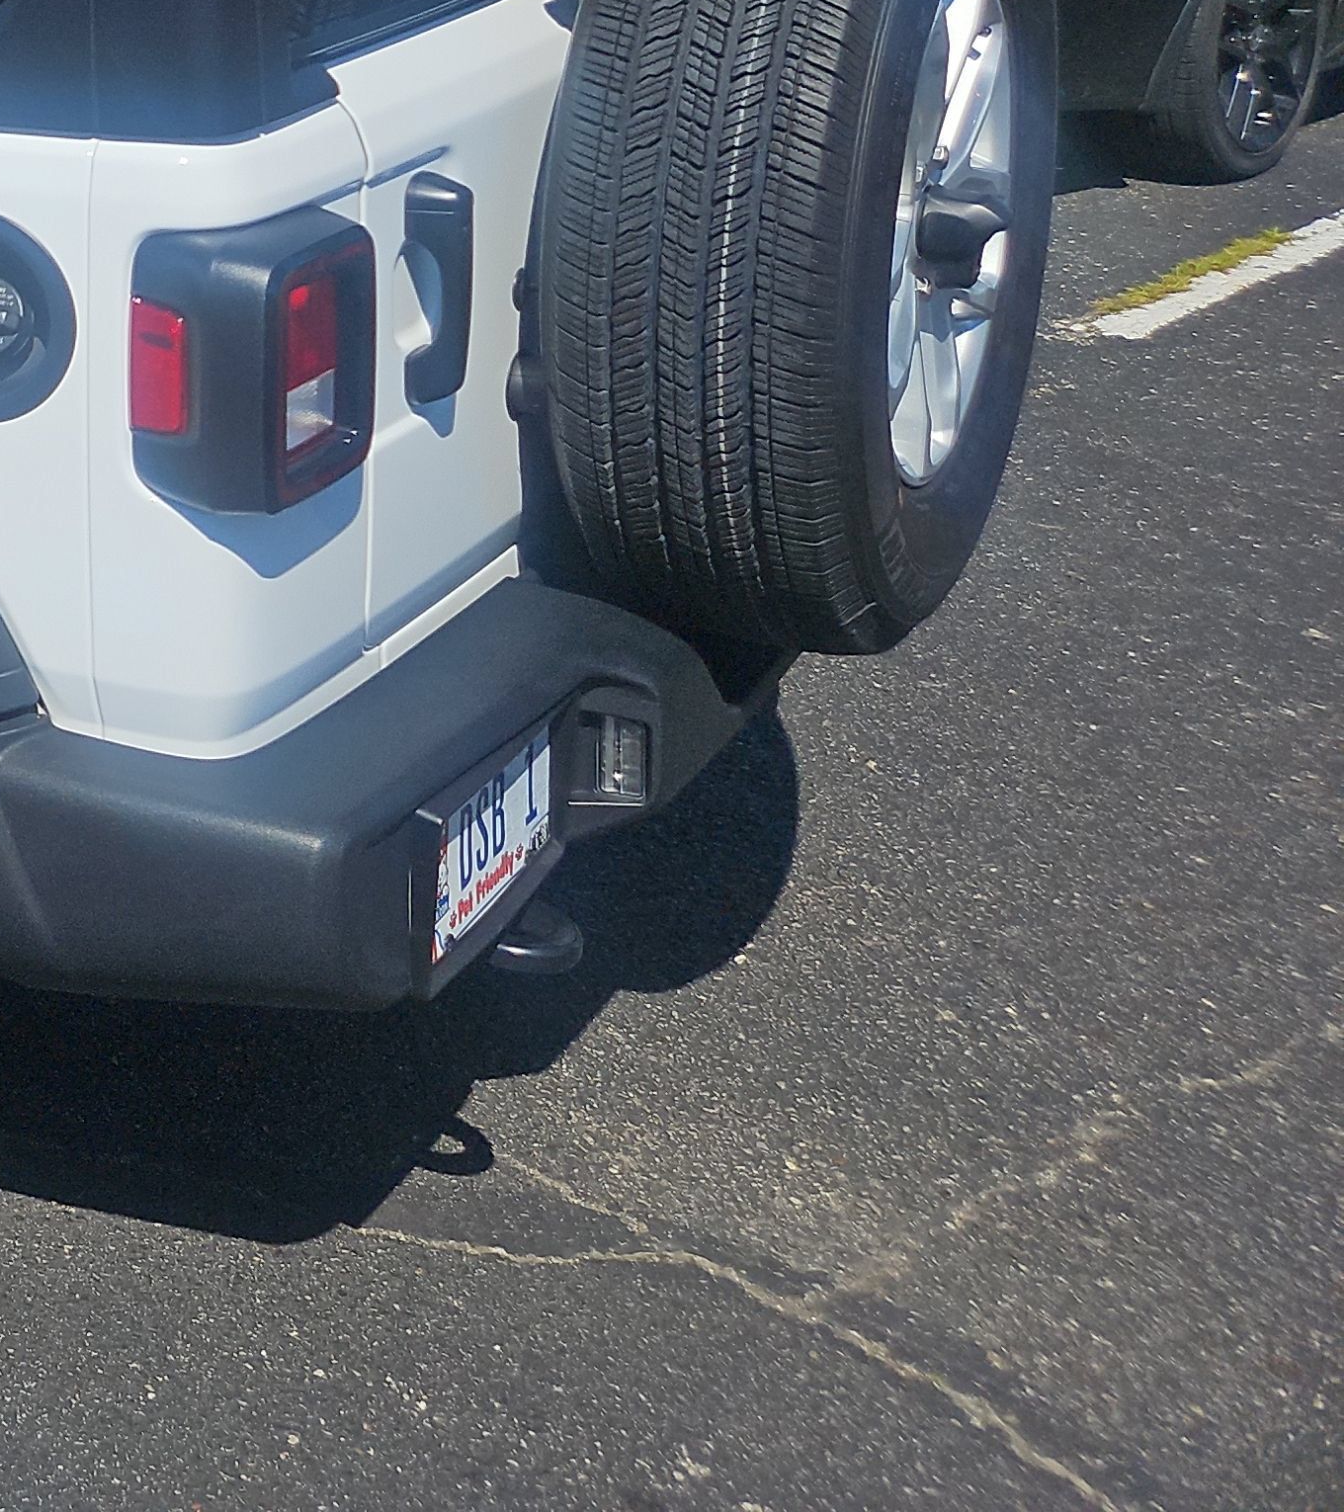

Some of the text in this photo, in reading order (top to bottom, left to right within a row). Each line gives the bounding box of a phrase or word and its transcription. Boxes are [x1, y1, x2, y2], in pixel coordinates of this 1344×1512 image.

[459, 740, 538, 892] DSB 1
[475, 848, 515, 905] Friendly
